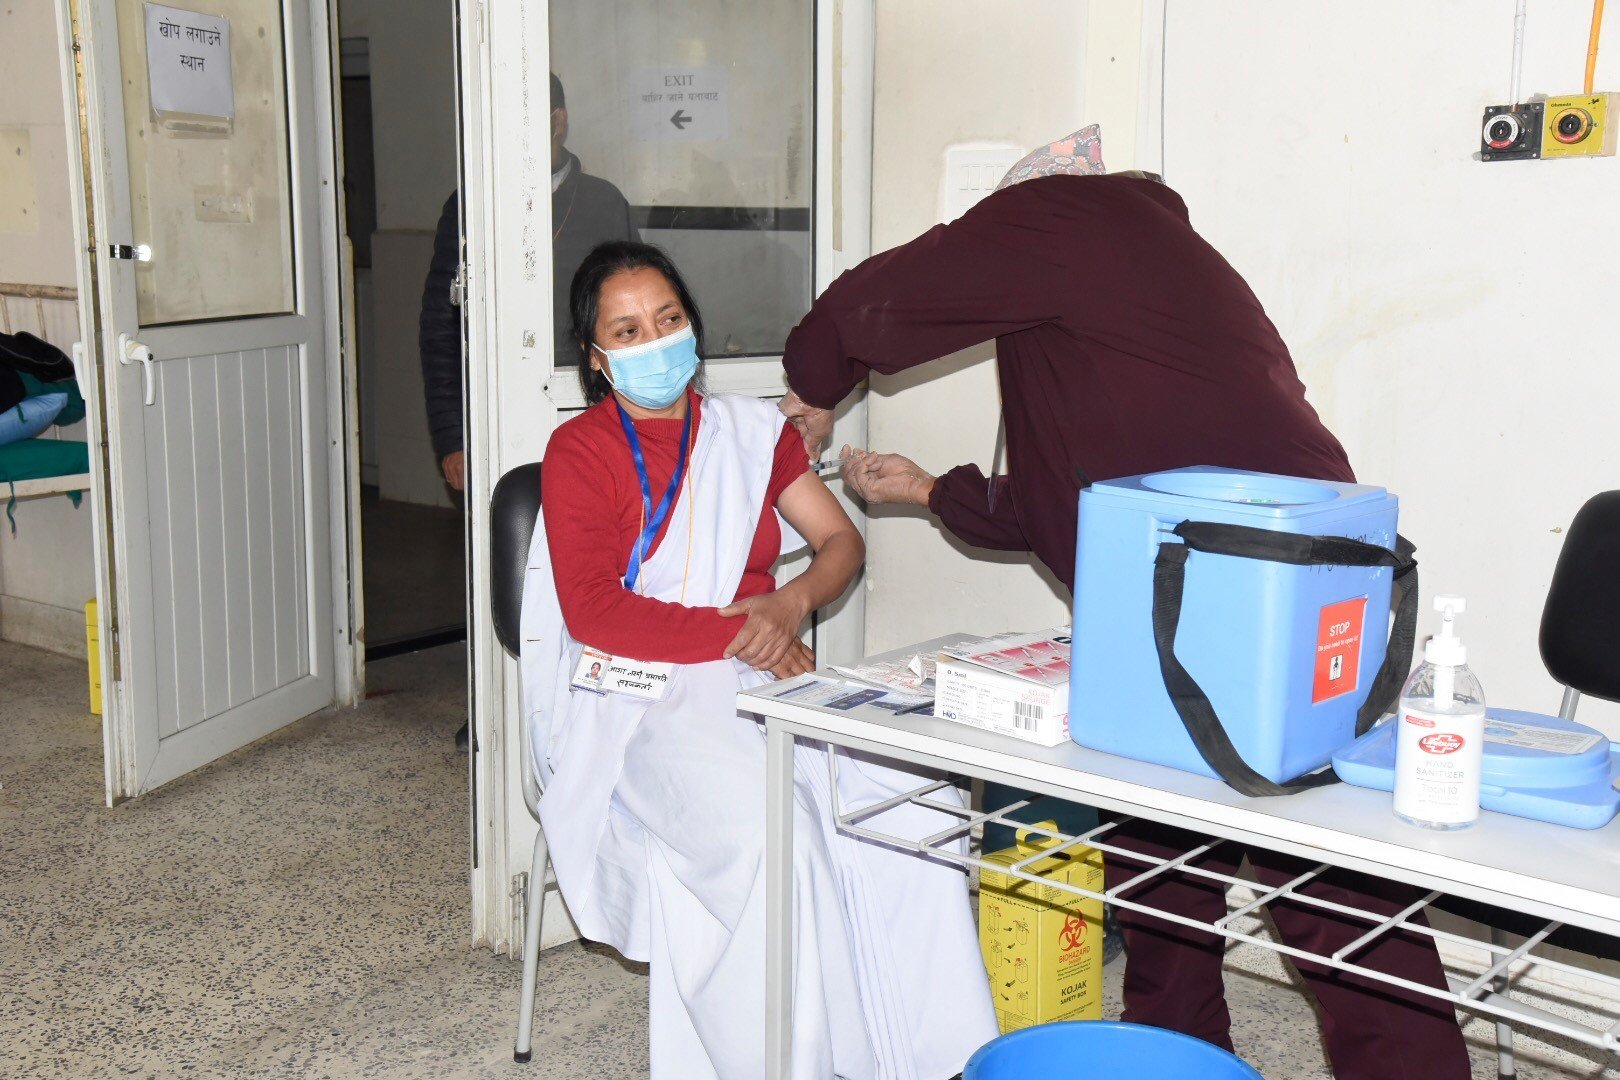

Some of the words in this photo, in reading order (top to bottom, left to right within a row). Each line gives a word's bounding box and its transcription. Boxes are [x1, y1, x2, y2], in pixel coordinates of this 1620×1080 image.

[159, 17, 181, 39] खोप
[186, 26, 221, 46] लगाउने
[180, 55, 205, 72] स्थान
[664, 75, 695, 86] EXIT
[1329, 622, 1350, 637] STOP
[1426, 761, 1453, 769] HAND
[1416, 767, 1464, 779] SANITIZER
[1059, 946, 1091, 964] BIOHAZARD
[1061, 980, 1088, 996] KOJAK
[1060, 994, 1077, 1005] SAFETY
[1077, 990, 1087, 999] BOX
